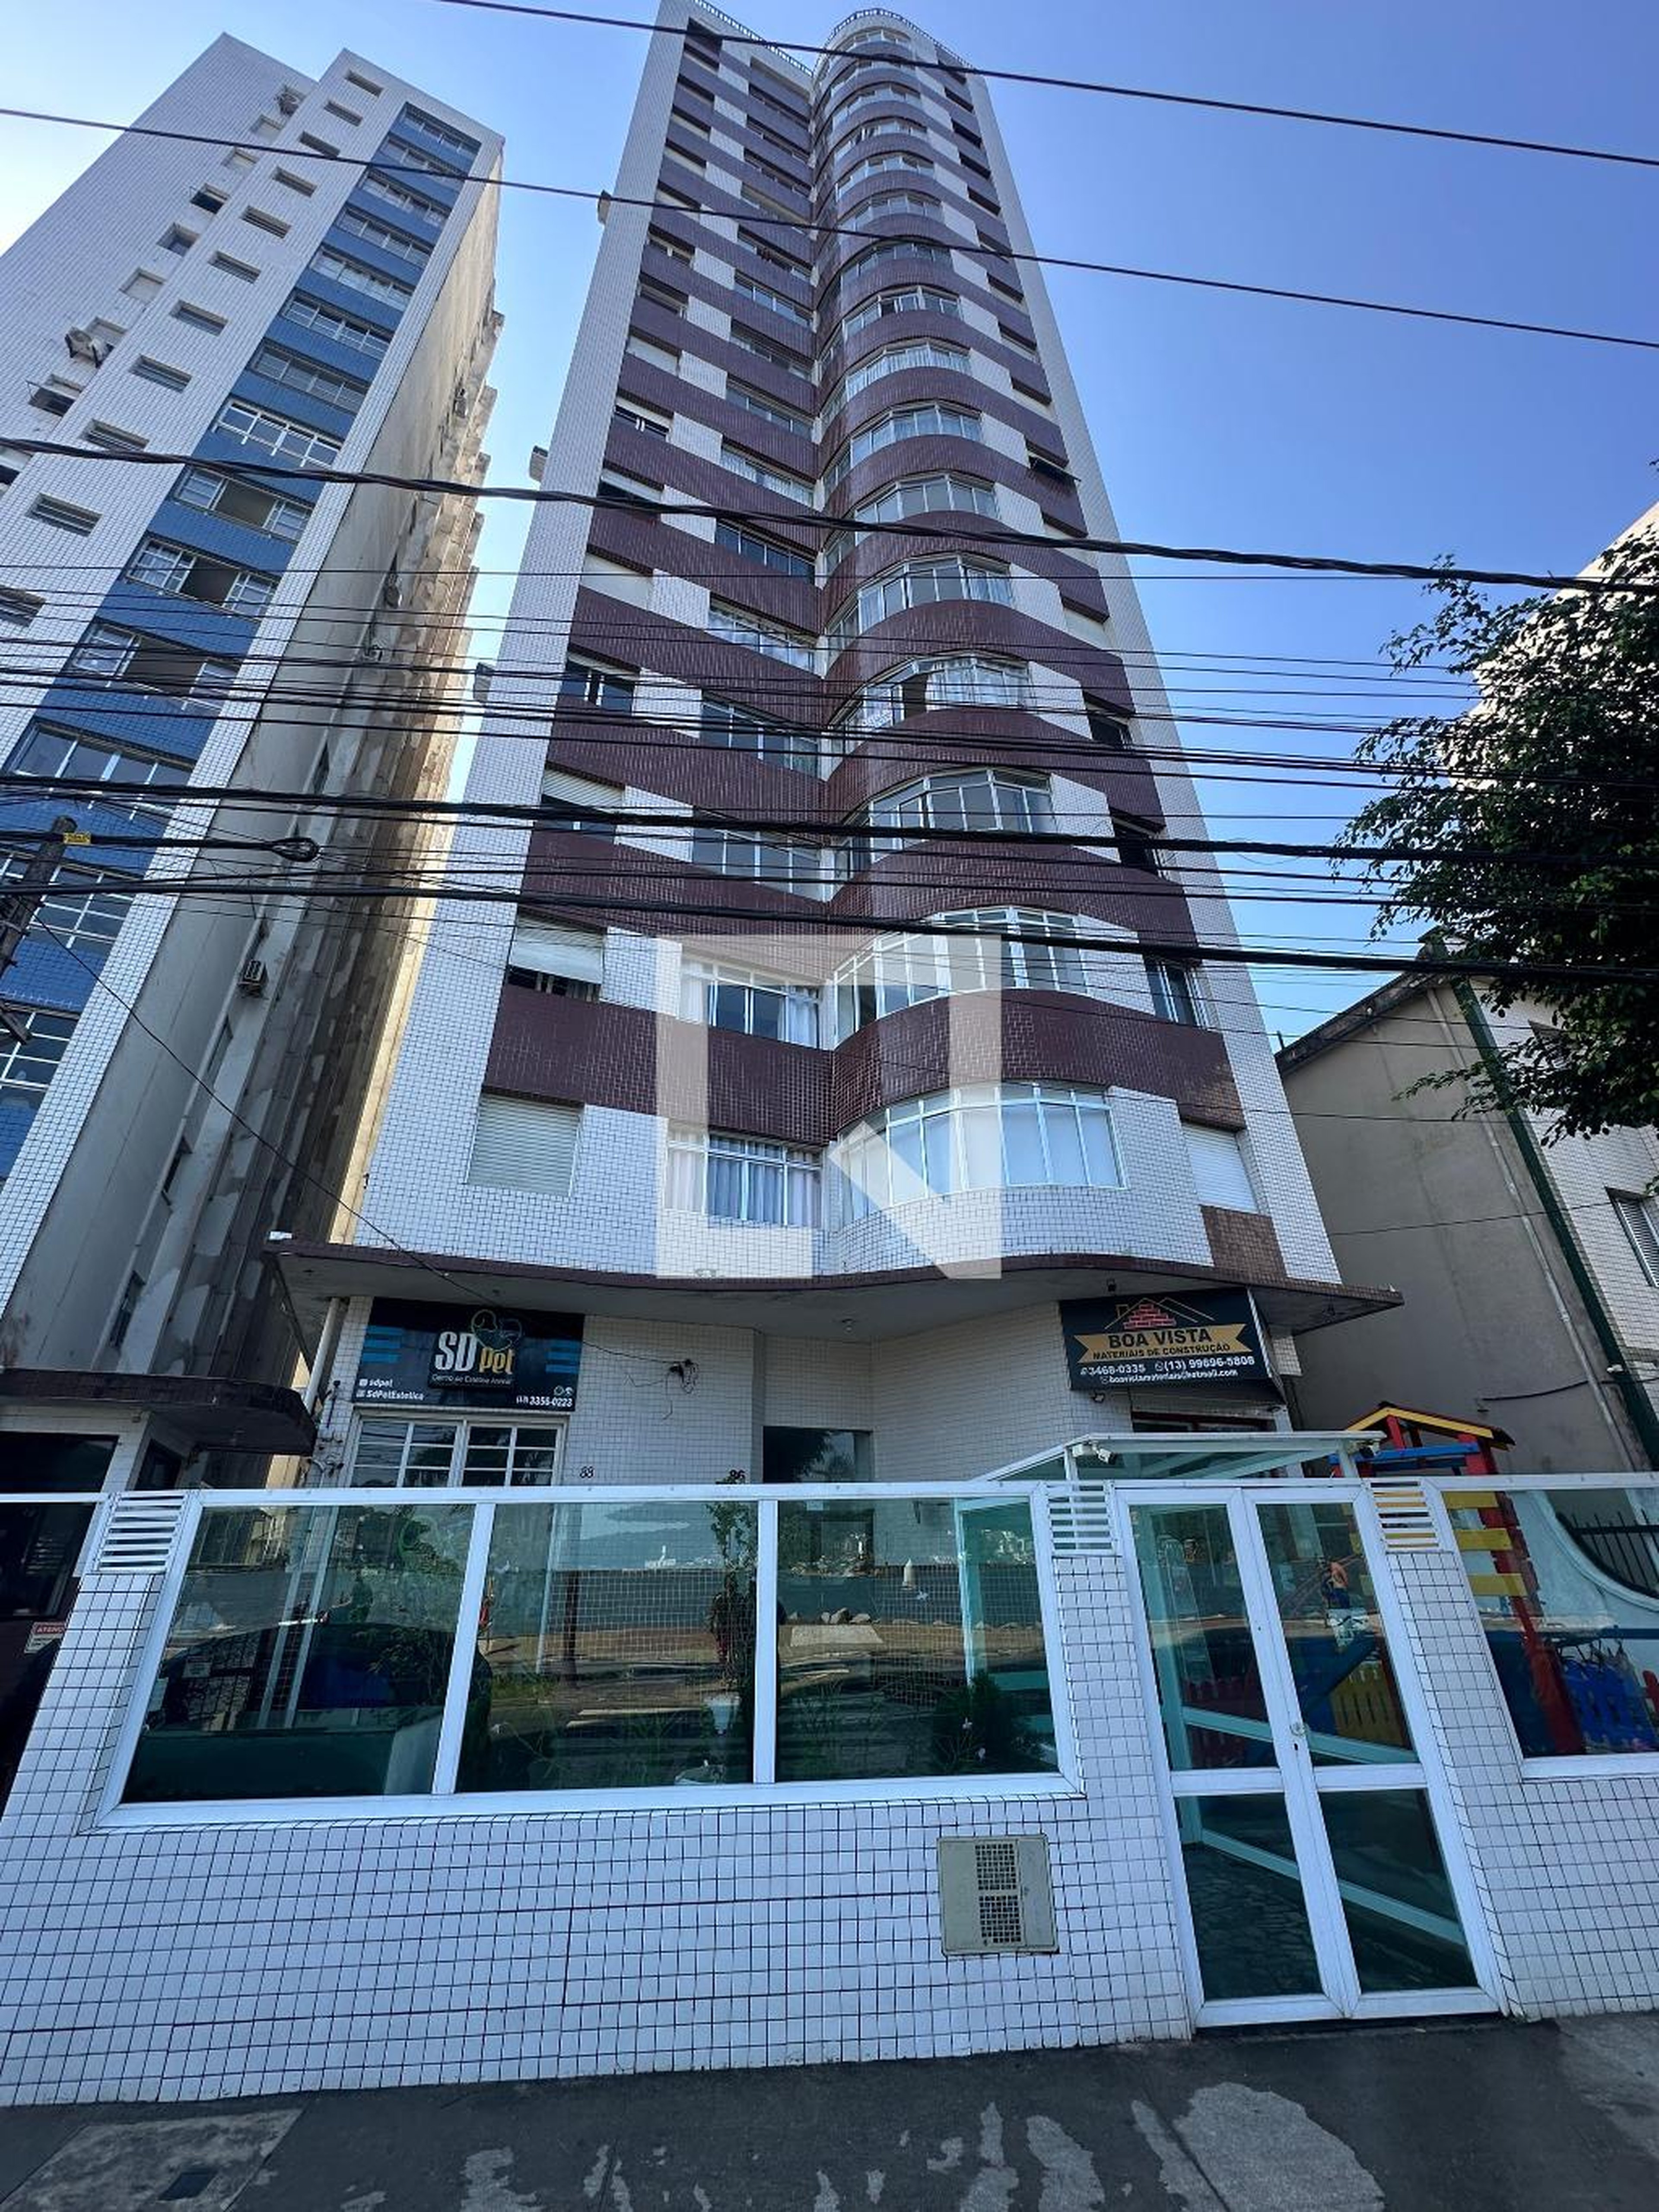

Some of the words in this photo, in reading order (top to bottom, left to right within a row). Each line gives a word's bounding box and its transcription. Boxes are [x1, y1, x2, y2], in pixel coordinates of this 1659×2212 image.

[1108, 1333, 1149, 1349] BOA
[1153, 1328, 1212, 1346] VISTA
[435, 1331, 477, 1372] SD
[1093, 1349, 1144, 1360] MATERIAIS
[1147, 1348, 1160, 1356] DE
[1163, 1341, 1230, 1355] CONSTRUÇÃO
[1164, 1359, 1186, 1372] (13)
[579, 1466, 594, 1479] 88
